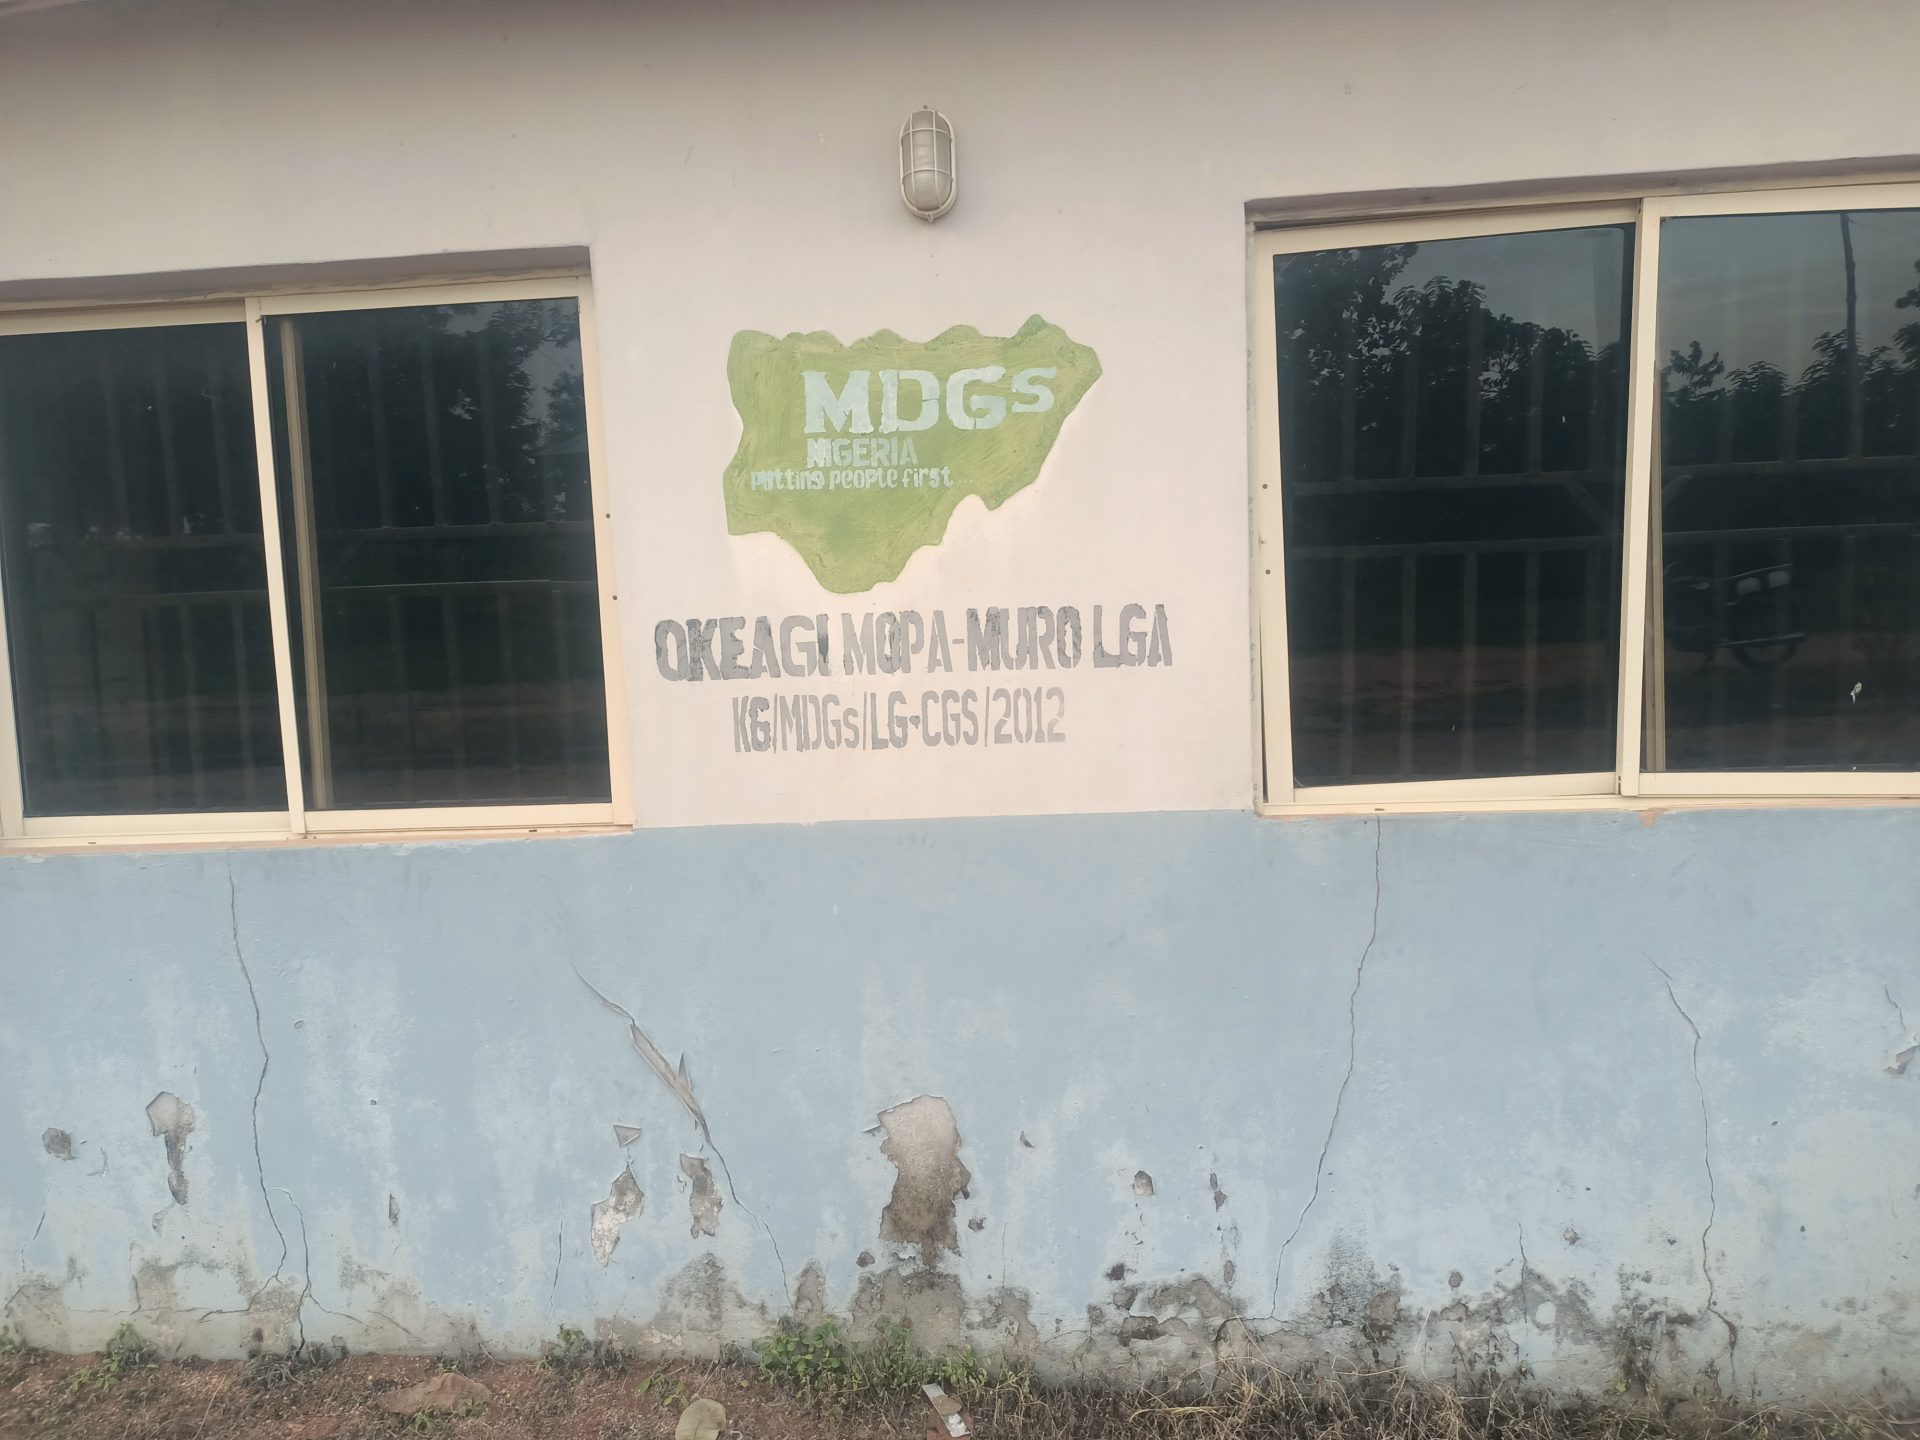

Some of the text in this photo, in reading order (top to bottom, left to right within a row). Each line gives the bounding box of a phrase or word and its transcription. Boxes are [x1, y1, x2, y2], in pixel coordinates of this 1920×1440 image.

[806, 437, 918, 468] NIGERIA
[829, 468, 898, 490] people
[654, 604, 1173, 681] OKEAGI MOPA-MURO LGA
